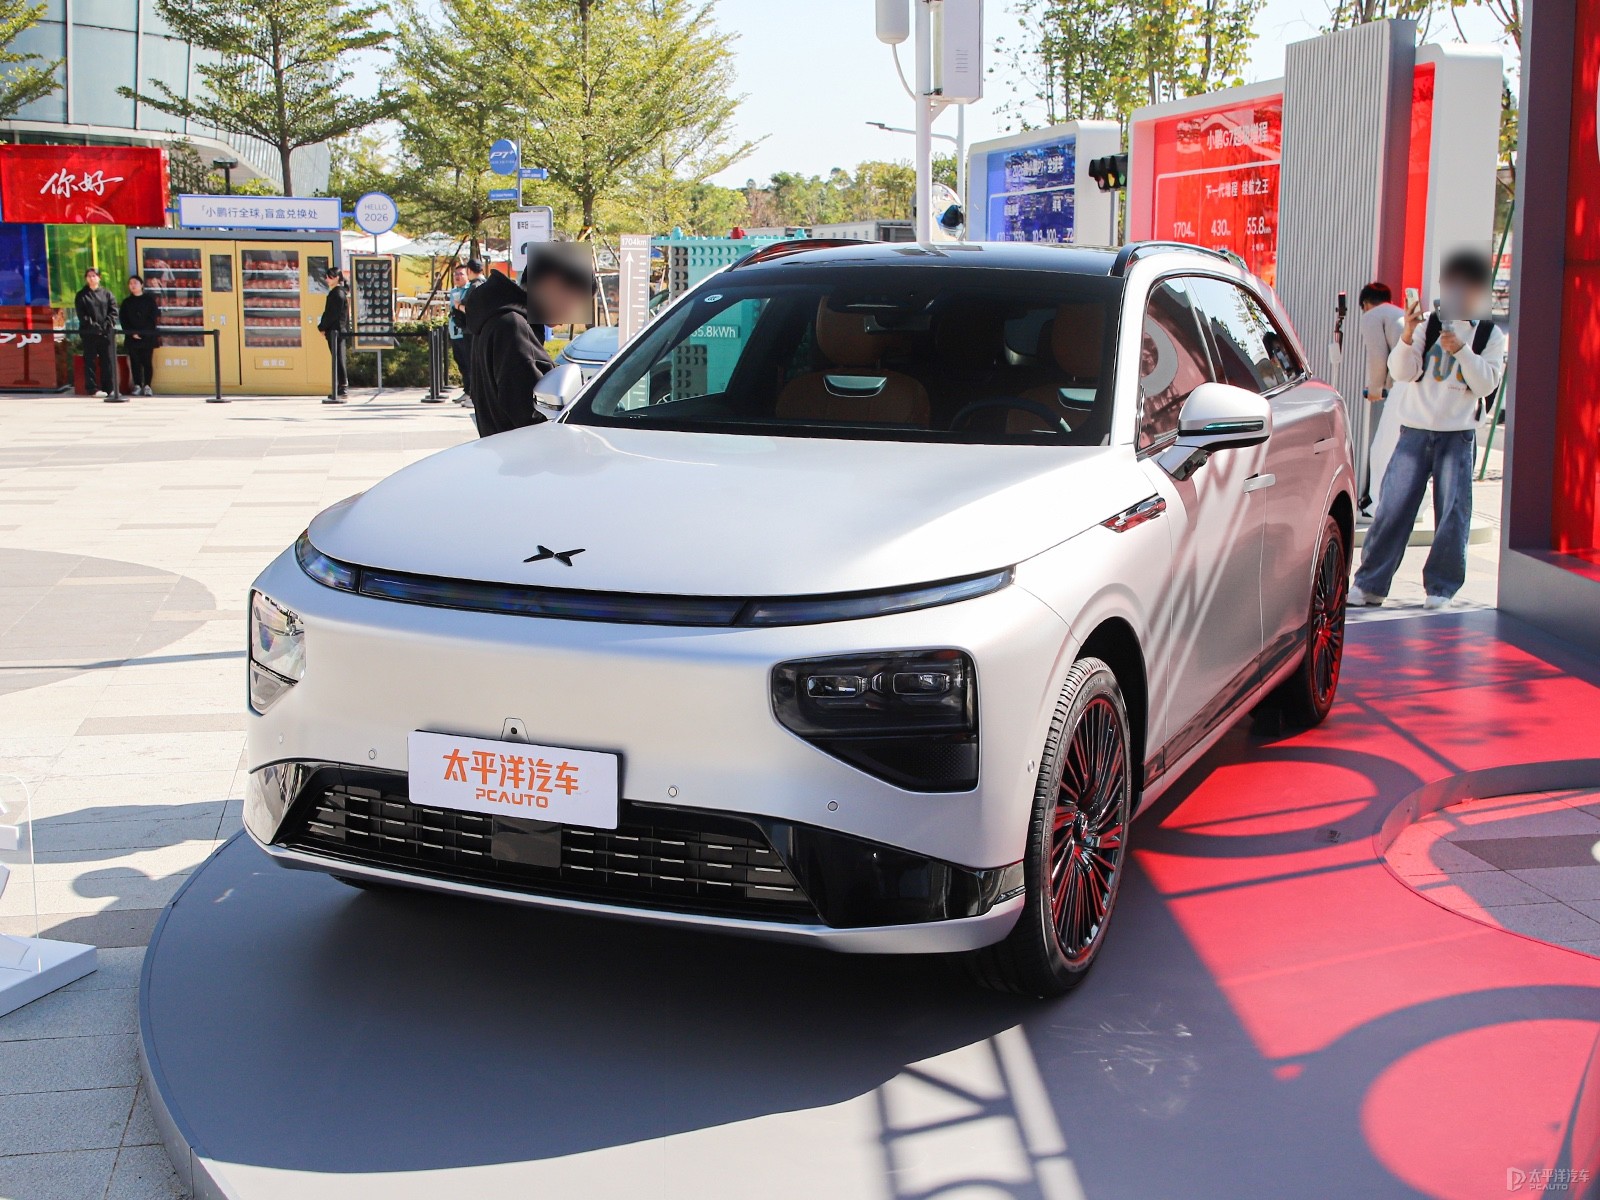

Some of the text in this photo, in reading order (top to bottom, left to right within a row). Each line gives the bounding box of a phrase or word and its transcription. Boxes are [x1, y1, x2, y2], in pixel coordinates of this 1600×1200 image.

[40, 167, 124, 198] 你好
[1241, 178, 1269, 196] 续航之王
[364, 203, 388, 211] HELLO
[364, 213, 389, 222] 2026
[622, 237, 647, 246] 1704km
[443, 748, 579, 795] 太平洋汽车
[476, 788, 549, 808] PCAUTO
